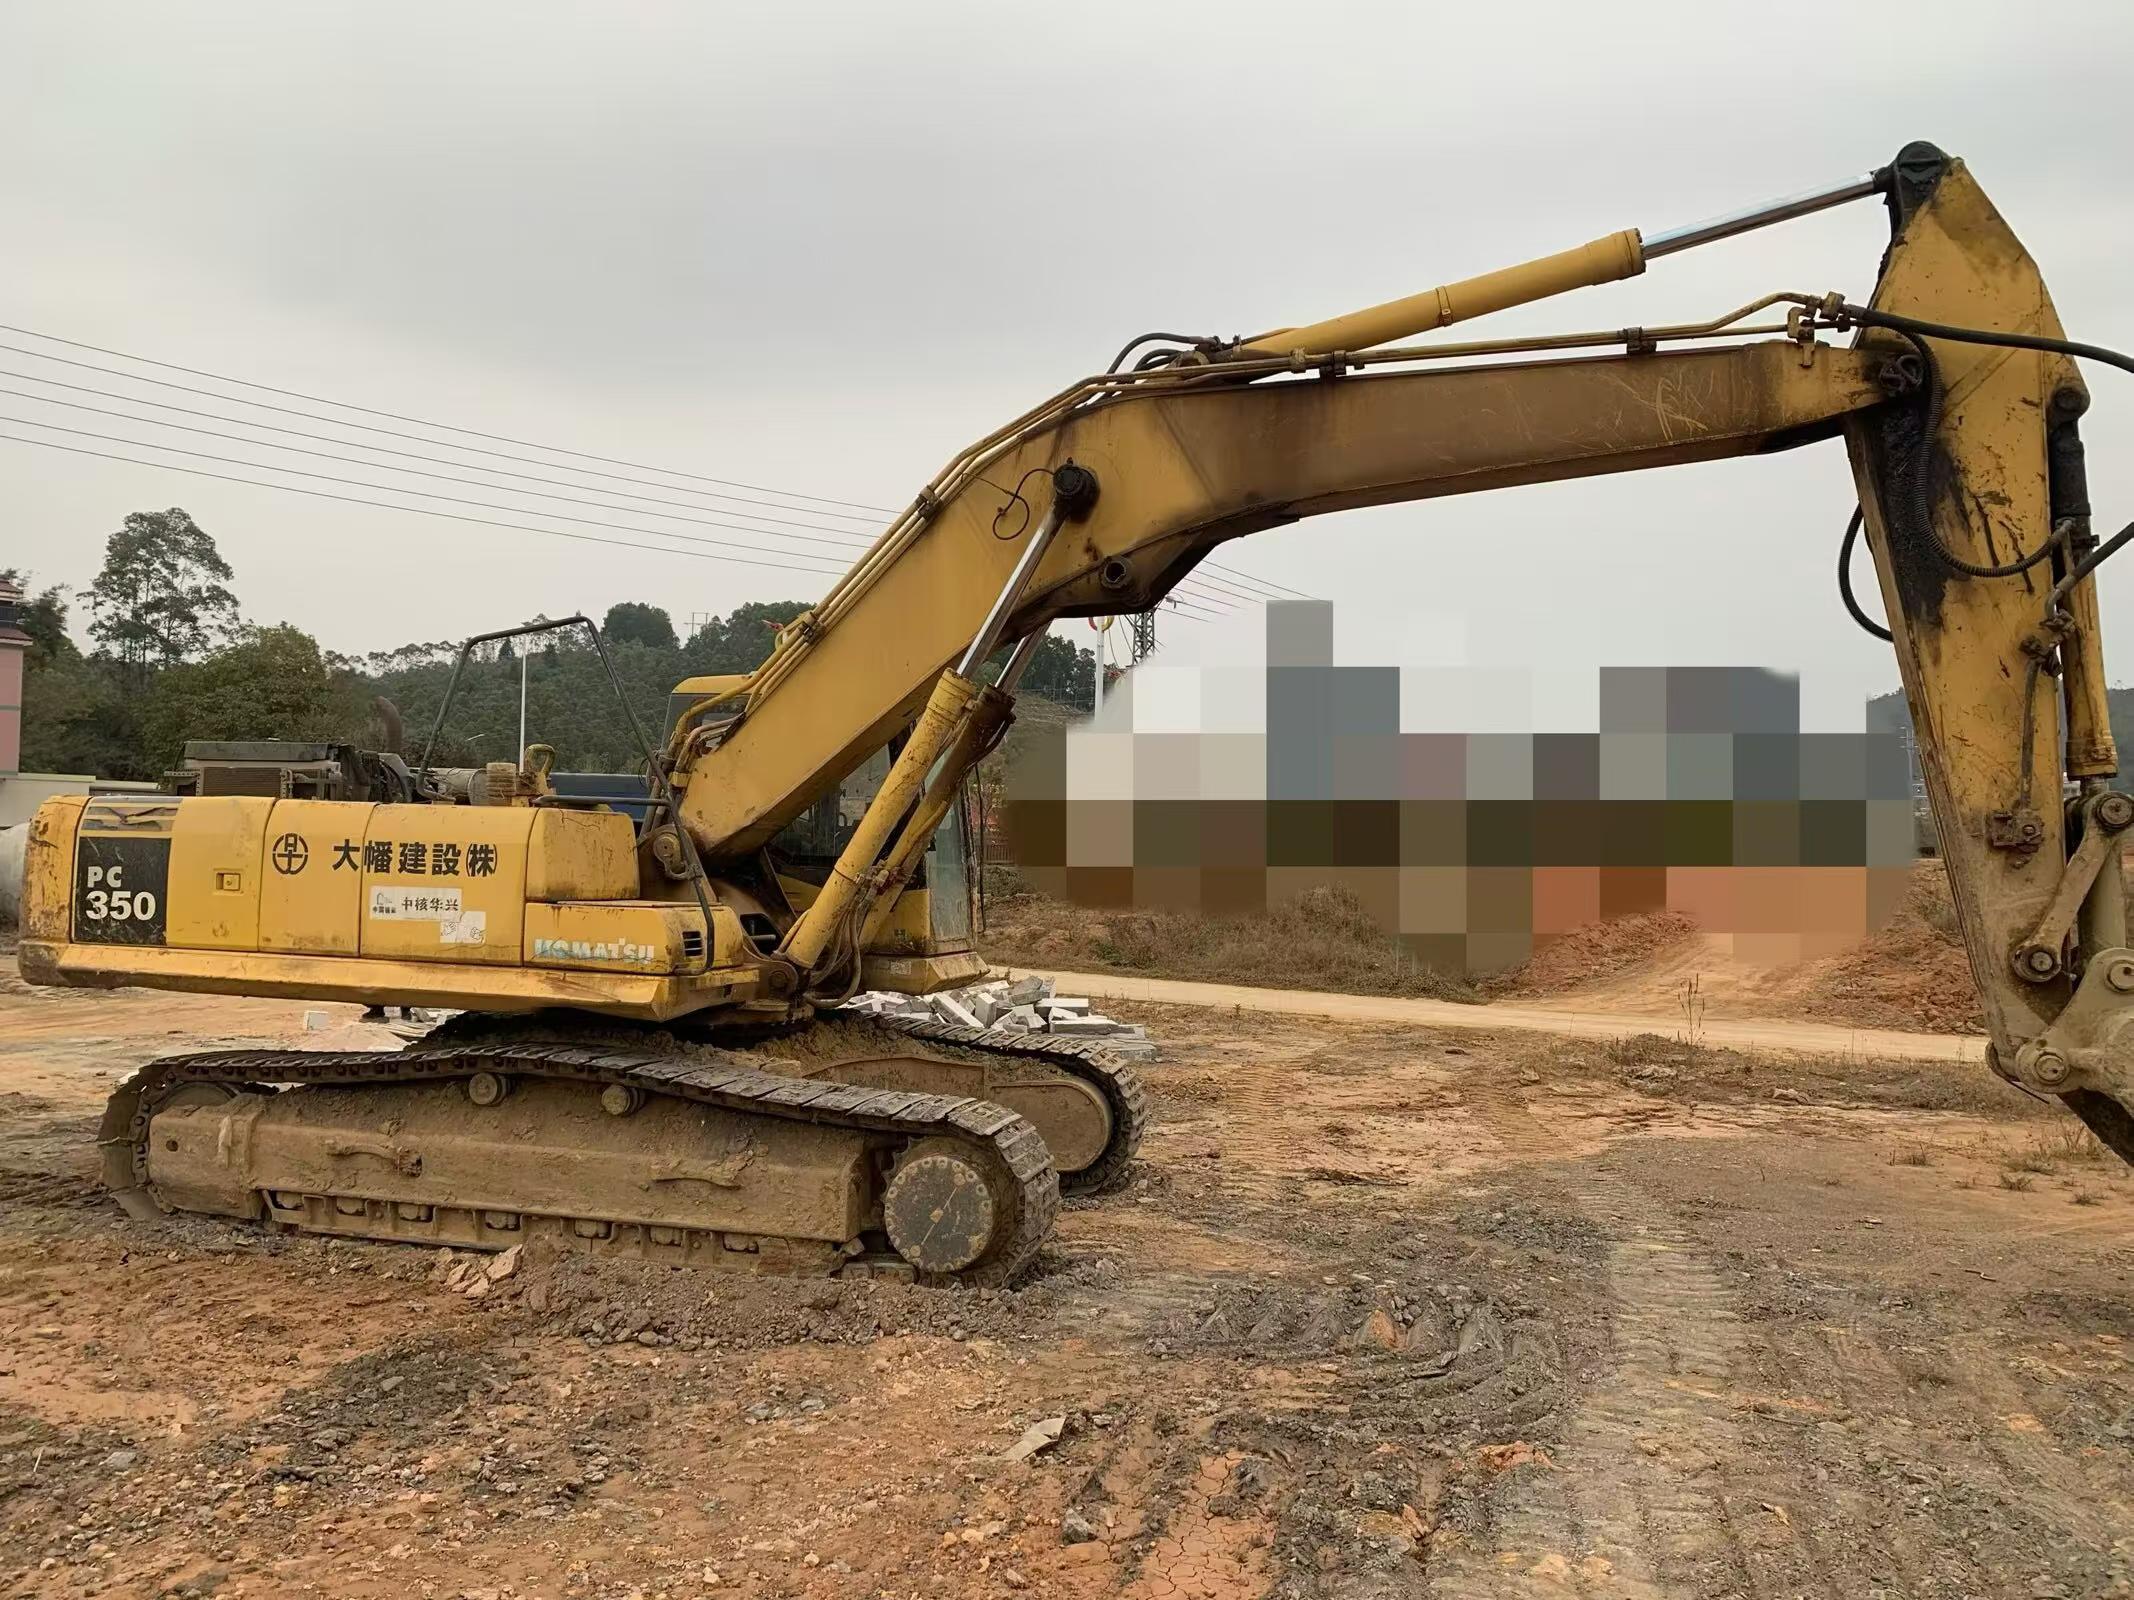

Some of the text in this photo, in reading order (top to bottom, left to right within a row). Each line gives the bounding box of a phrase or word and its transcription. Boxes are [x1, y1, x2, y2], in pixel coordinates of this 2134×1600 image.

[87, 866, 122, 888] PC
[86, 891, 156, 921] 350
[401, 897, 459, 912] 中核华兴
